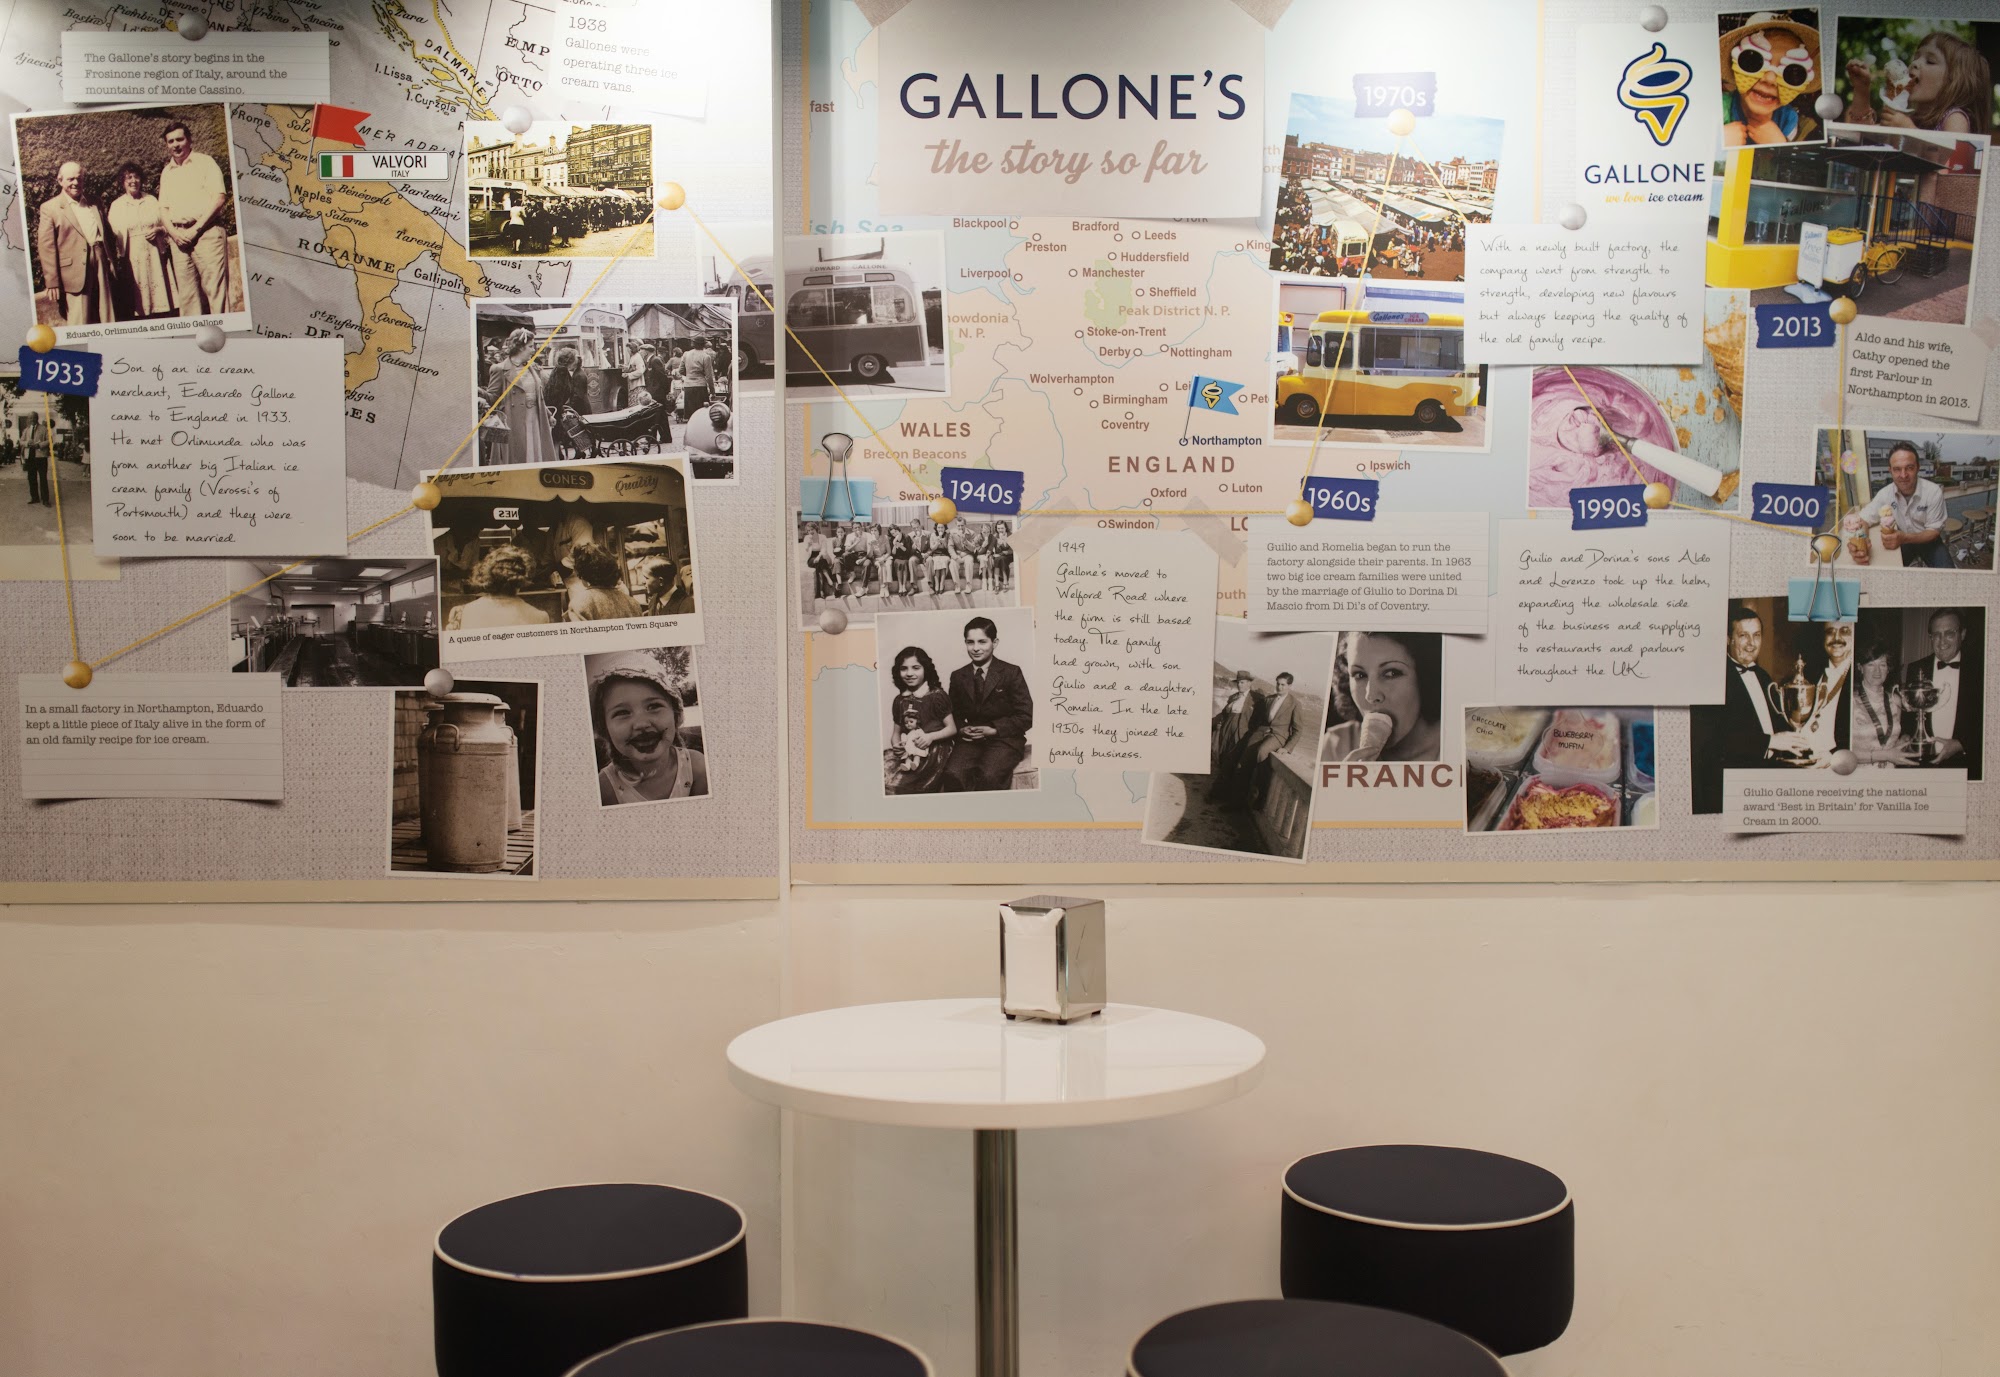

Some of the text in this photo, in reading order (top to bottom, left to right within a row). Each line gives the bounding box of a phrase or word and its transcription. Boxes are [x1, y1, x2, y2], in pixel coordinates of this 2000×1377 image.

[569, 16, 606, 32] 1938
[566, 37, 649, 56] Gallones were
[84, 53, 264, 64] The Gallone's story begins in the
[564, 58, 622, 74] operating
[626, 64, 657, 76] three
[85, 69, 287, 80] Frosinone region of Italy, around the
[562, 77, 599, 88] cream
[86, 85, 244, 94] mountains of Monte Cassino.
[900, 70, 1245, 120] GALLONE'S
[1364, 86, 1426, 106] 1970s
[238, 109, 271, 128] Rome
[372, 155, 426, 168] VALVORI
[924, 139, 1208, 184] the story so far
[1585, 164, 1705, 184] GALLONE
[294, 185, 332, 204] Naples
[1648, 193, 1703, 202] ice cream
[954, 218, 1006, 230] Blackpool
[1073, 221, 1119, 231] Bradford
[396, 230, 442, 250] Tarente
[1145, 231, 1176, 240] Leeds
[1026, 242, 1066, 251] Preston
[1121, 252, 1188, 262] Huddersfield
[961, 268, 1010, 280] Liverpool
[1083, 268, 1144, 277] Manchester
[1480, 263, 1670, 282] company went from strength to
[414, 268, 462, 291] Gallipoli
[1150, 287, 1196, 296] Sheffield
[66, 330, 103, 339] Eduardo,
[104, 326, 148, 335] Orlimunda
[167, 322, 191, 330] Giulio
[192, 320, 223, 328] Gallone
[1087, 327, 1166, 336] Stoke-on-Trent
[1772, 317, 1821, 336] 2013
[1855, 332, 1953, 354] Aldo and his wife,
[1100, 347, 1130, 358] Derby
[1170, 347, 1232, 359] Nottingham
[380, 353, 439, 377] Catanzaro
[1852, 349, 1950, 370] Cathy opened the
[36, 360, 83, 385] 1933
[111, 358, 144, 374] Son
[152, 364, 164, 381] of
[196, 365, 212, 373] ice
[1030, 374, 1114, 385] Wolverhampton
[178, 382, 242, 398] Eduardo
[251, 385, 296, 406] Gallone
[1103, 395, 1167, 406] Birmingham
[1847, 384, 1970, 408] Northampton in 2013.
[900, 423, 970, 437] WALES
[1102, 420, 1149, 432] Coventry
[1193, 436, 1261, 447] Northampton
[1109, 456, 1234, 472] ENGLAND
[1370, 461, 1410, 472] Ipswich
[542, 473, 586, 485] CONES
[614, 475, 659, 496] Quality
[948, 480, 1012, 504] 1940s
[1151, 488, 1186, 497] Oxford
[1232, 483, 1262, 492] Luton
[1308, 488, 1370, 512] 1960s
[1760, 494, 1819, 518] 2000
[1578, 498, 1641, 519] 1990s
[1108, 520, 1154, 528] Swindon
[1059, 542, 1085, 553] 1949
[1267, 543, 1297, 551] Guilio
[1300, 543, 1319, 551] and
[1322, 543, 1364, 551] Romelia
[1366, 543, 1397, 553] began
[1434, 543, 1450, 551] the
[1115, 570, 1149, 578] moved
[1157, 569, 1167, 578] to
[1519, 576, 1542, 585] and
[1549, 572, 1595, 588] Lorenzo
[1603, 575, 1624, 585] took
[1632, 579, 1647, 590] up
[1656, 574, 1674, 585] the
[457, 636, 481, 644] queue
[516, 630, 558, 638] customers
[570, 625, 624, 634] Northampton
[650, 621, 678, 629] Square
[25, 705, 37, 713] In
[49, 705, 78, 713] small
[81, 704, 121, 715] factory
[124, 705, 134, 713] in
[137, 704, 214, 714] Northampton,
[217, 704, 263, 712] Eduardo
[43, 736, 59, 744] old
[62, 735, 96, 746] family
[99, 736, 133, 746] recipe
[136, 735, 151, 744] for
[154, 735, 169, 744] ice
[1553, 728, 1594, 742] BLUEBERRY
[1558, 741, 1584, 751] MUFFIN
[1049, 747, 1084, 764] family
[1323, 764, 1462, 787] FRANC
[1744, 788, 1927, 798] Giulio Gallone receiving the national
[1743, 817, 1821, 826] Cream in 2000.
